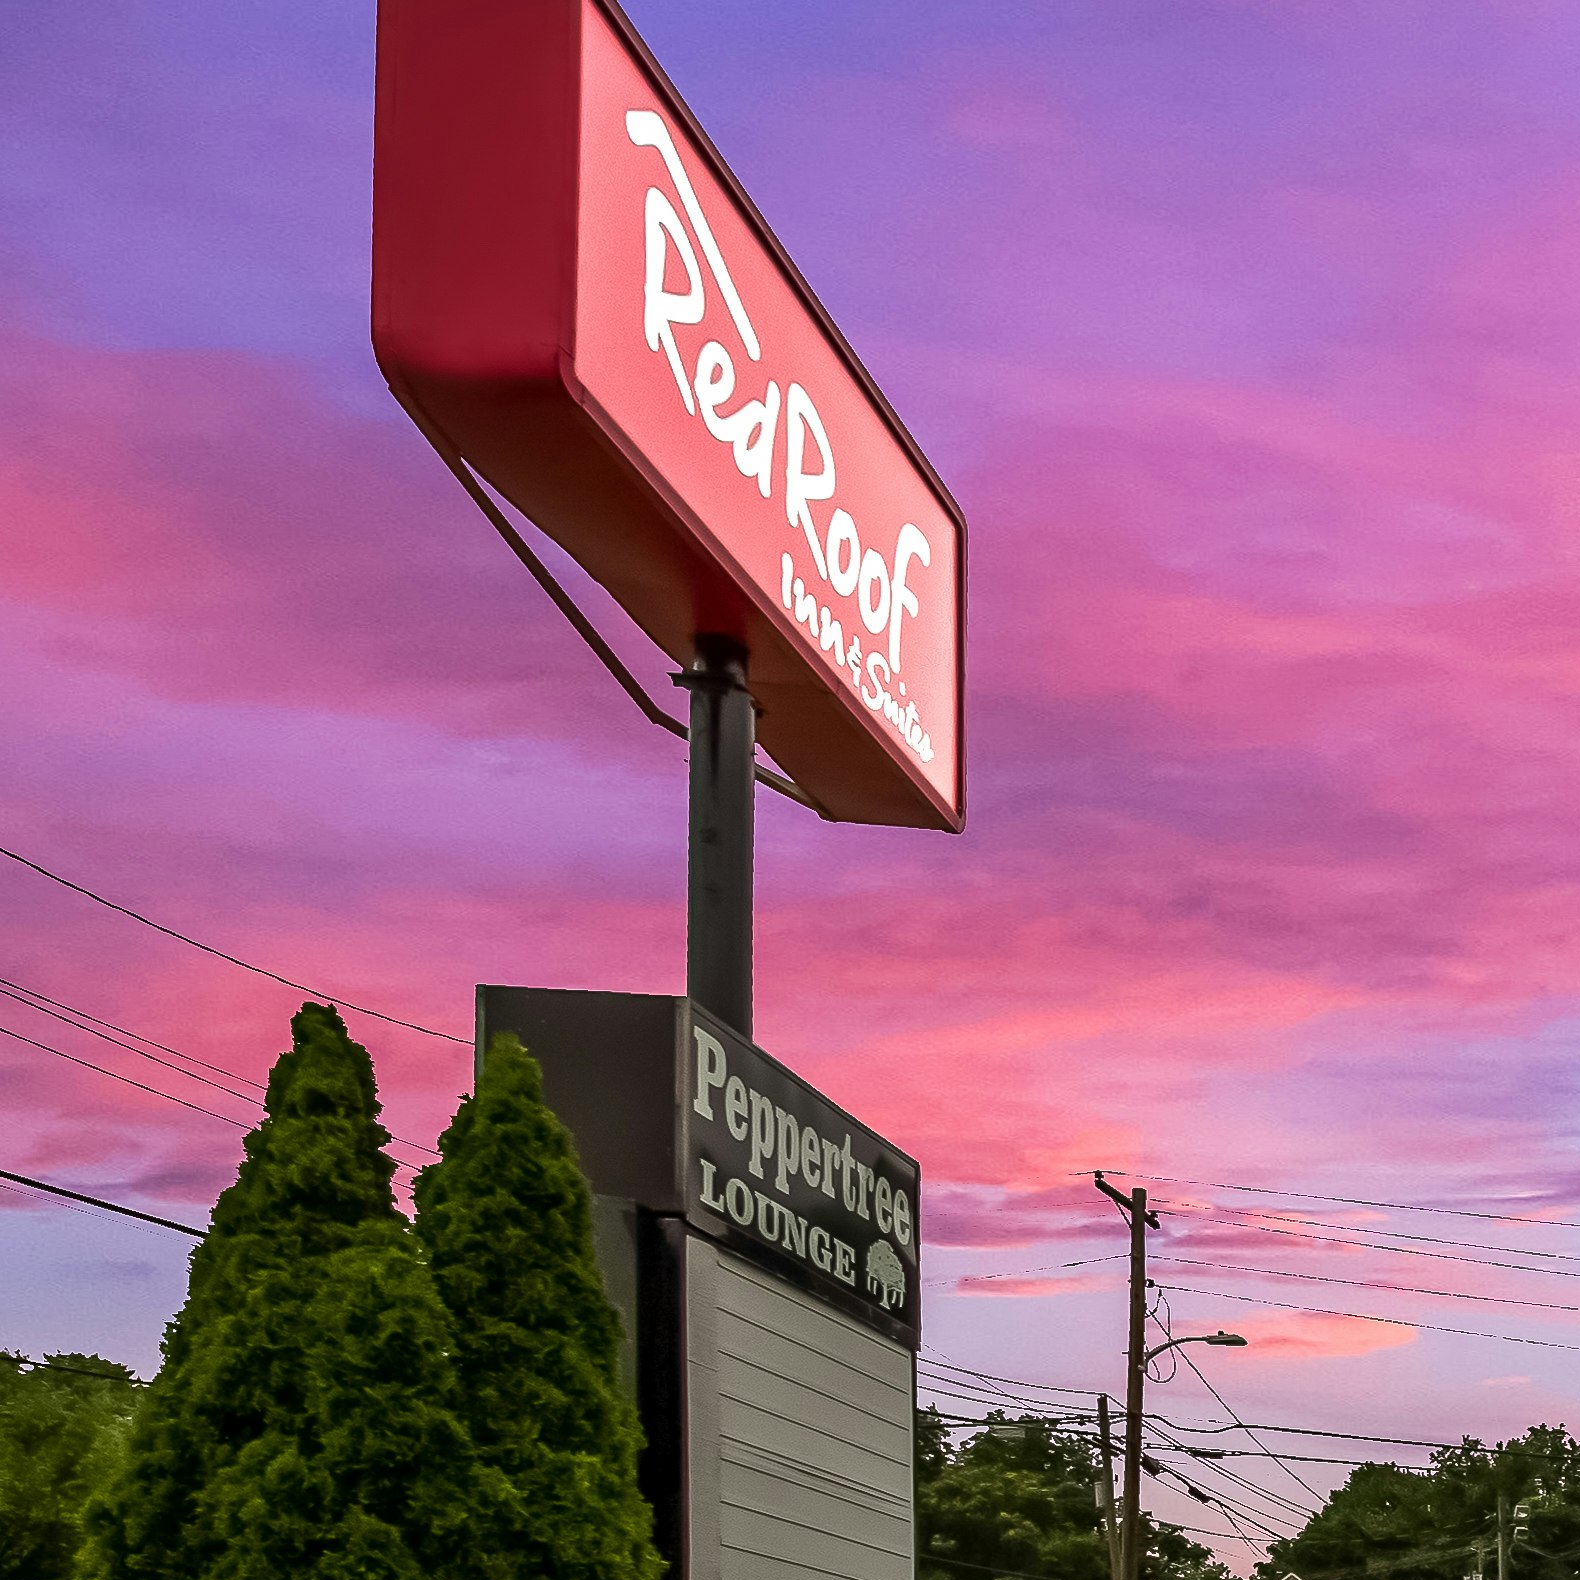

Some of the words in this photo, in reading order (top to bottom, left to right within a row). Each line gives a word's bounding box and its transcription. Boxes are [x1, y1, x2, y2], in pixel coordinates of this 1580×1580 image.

[643, 186, 781, 498] Red
[787, 382, 931, 674] Roof
[781, 551, 846, 667] Inn
[693, 1025, 910, 1246] Peppertree
[700, 1158, 856, 1287] LOUNGE
